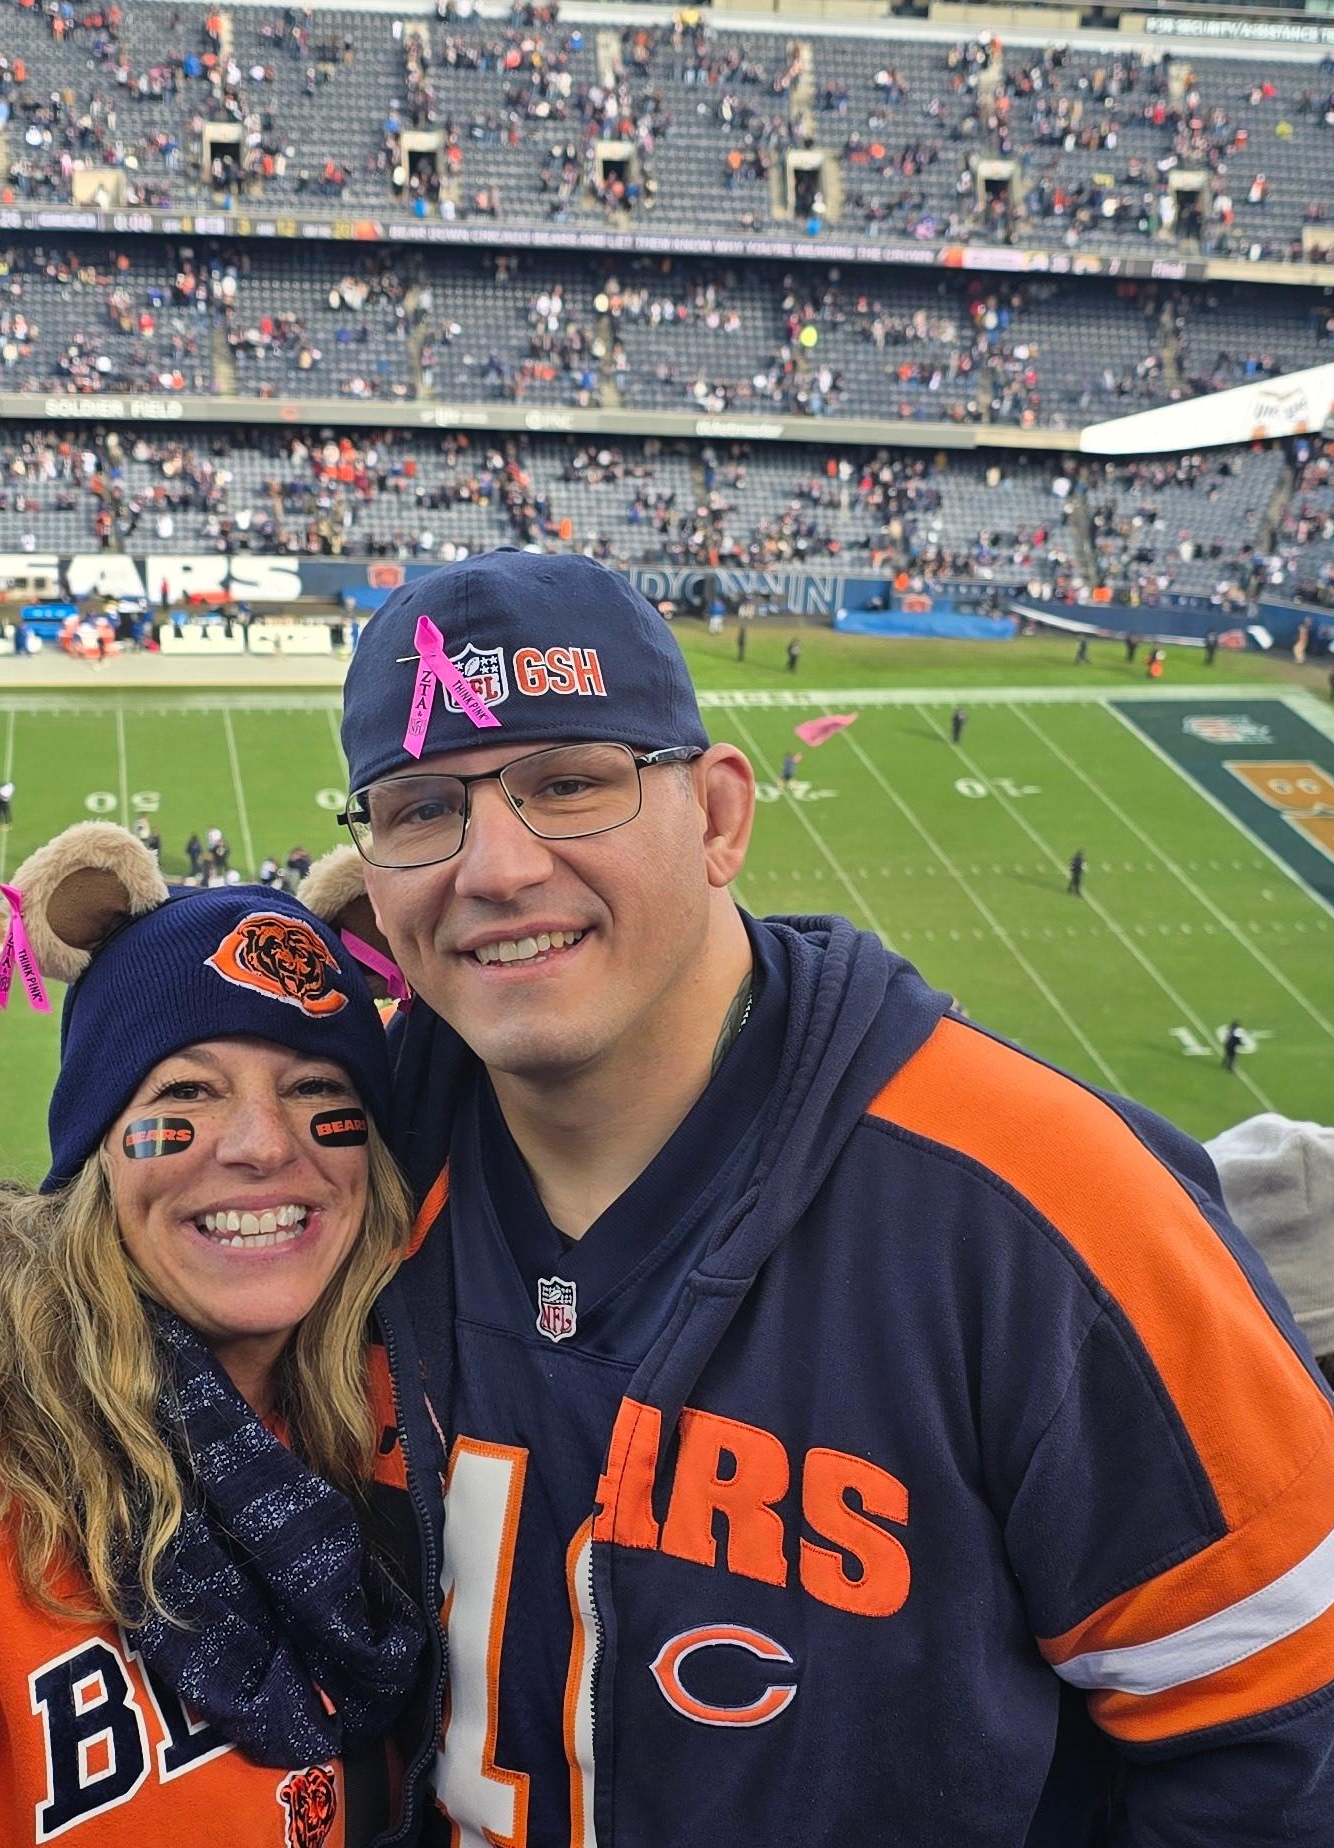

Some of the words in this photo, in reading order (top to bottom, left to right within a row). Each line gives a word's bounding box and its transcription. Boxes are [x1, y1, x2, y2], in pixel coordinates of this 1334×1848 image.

[45, 398, 123, 417] SOLDIER
[130, 399, 183, 418] FIELD
[513, 647, 607, 697] GSH
[414, 670, 433, 710] ZTA
[451, 679, 473, 706] THINK
[18, 948, 35, 978] THINK
[125, 1128, 192, 1147] BEARS
[649, 1622, 798, 1728] C
